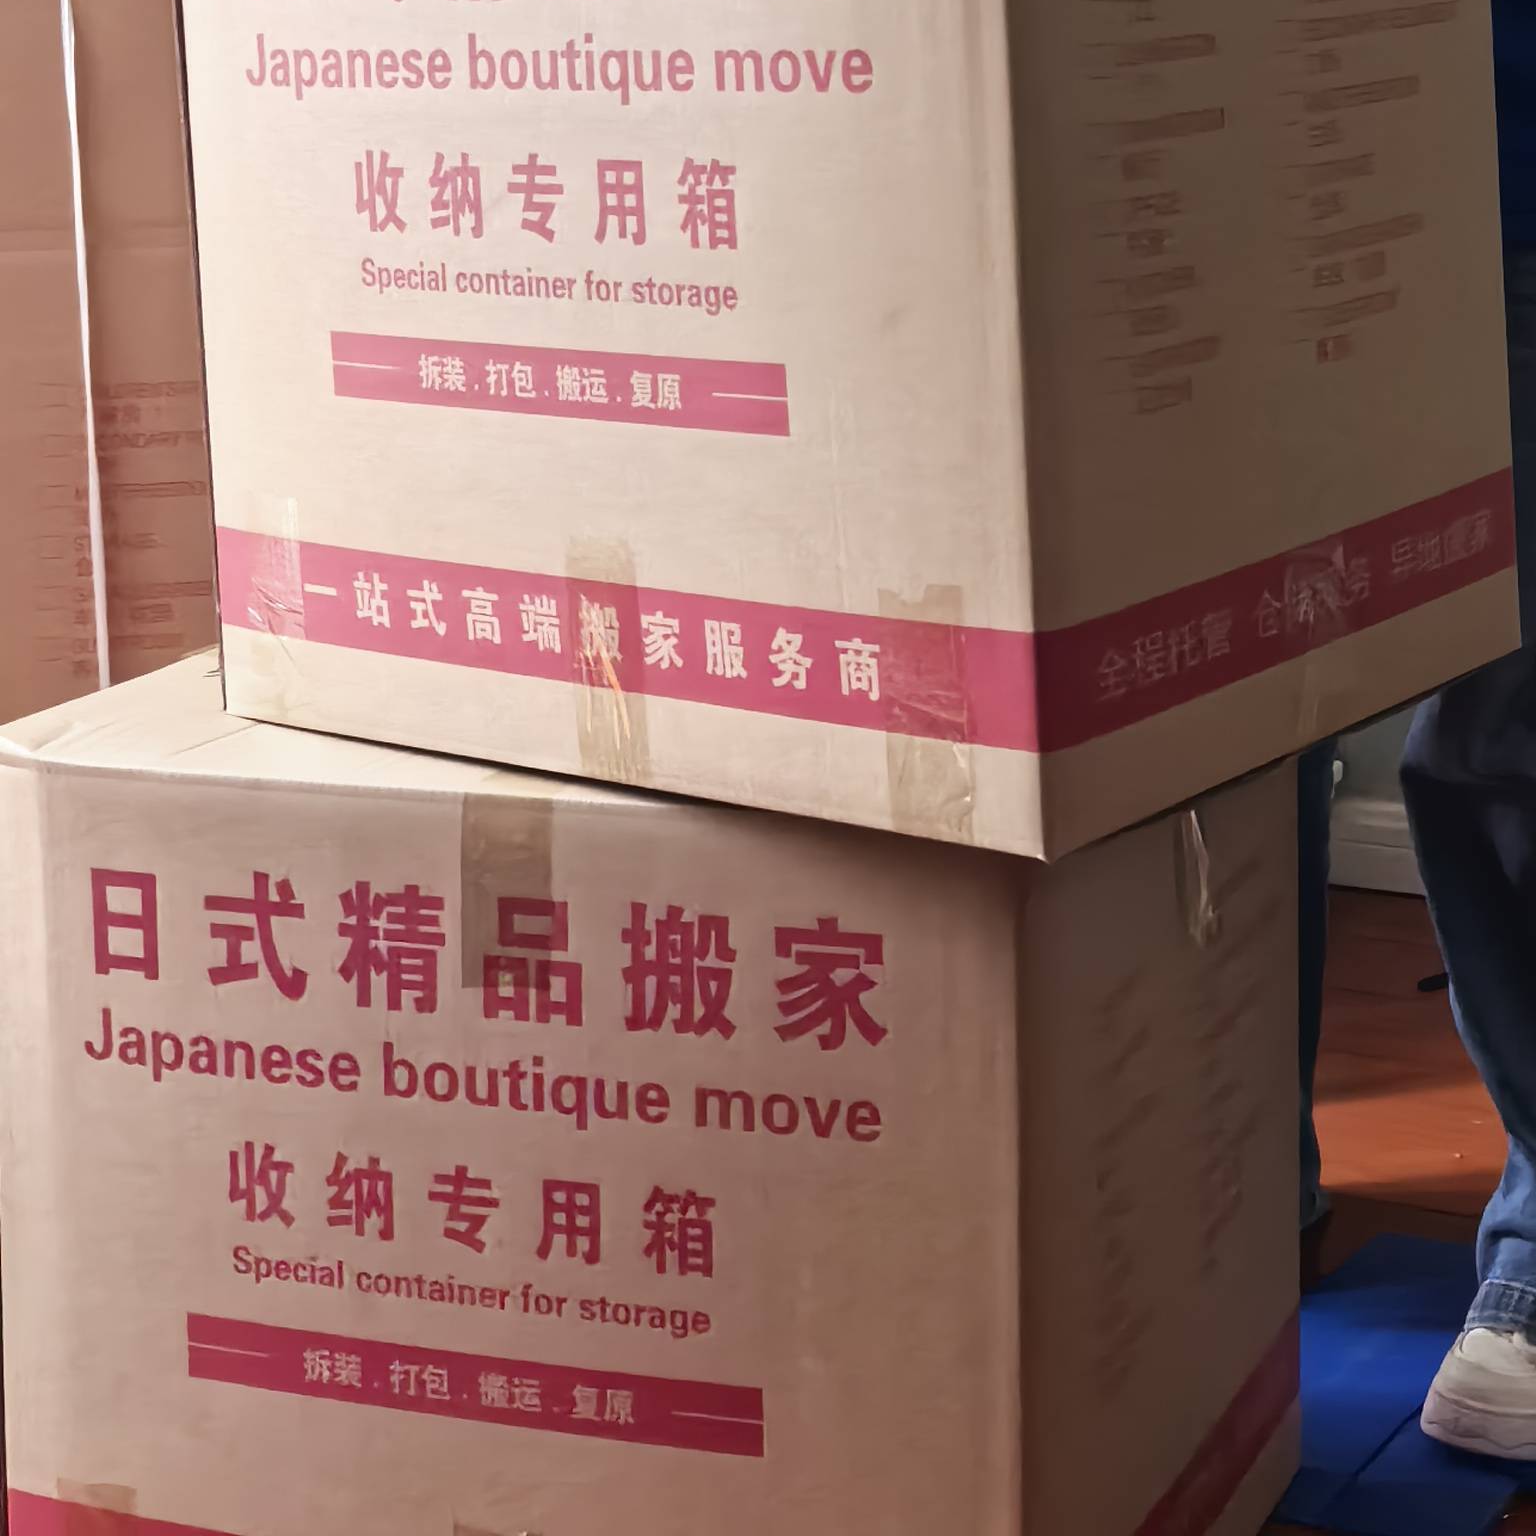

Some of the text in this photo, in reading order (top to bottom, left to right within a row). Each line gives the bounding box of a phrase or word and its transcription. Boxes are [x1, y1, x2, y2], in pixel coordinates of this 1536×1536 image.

[246, 33, 873, 105] Japanese boutique move
[354, 150, 738, 251] 收纳专用箱
[361, 258, 738, 316] Special container for storage
[302, 571, 884, 702] 一站式高端搬家服务商
[90, 867, 887, 1052] 日式精品搬家
[85, 1008, 882, 1142] Japanese boutique move
[228, 1141, 715, 1278] 收纳专用箱
[233, 1245, 711, 1337] Special container for storage
